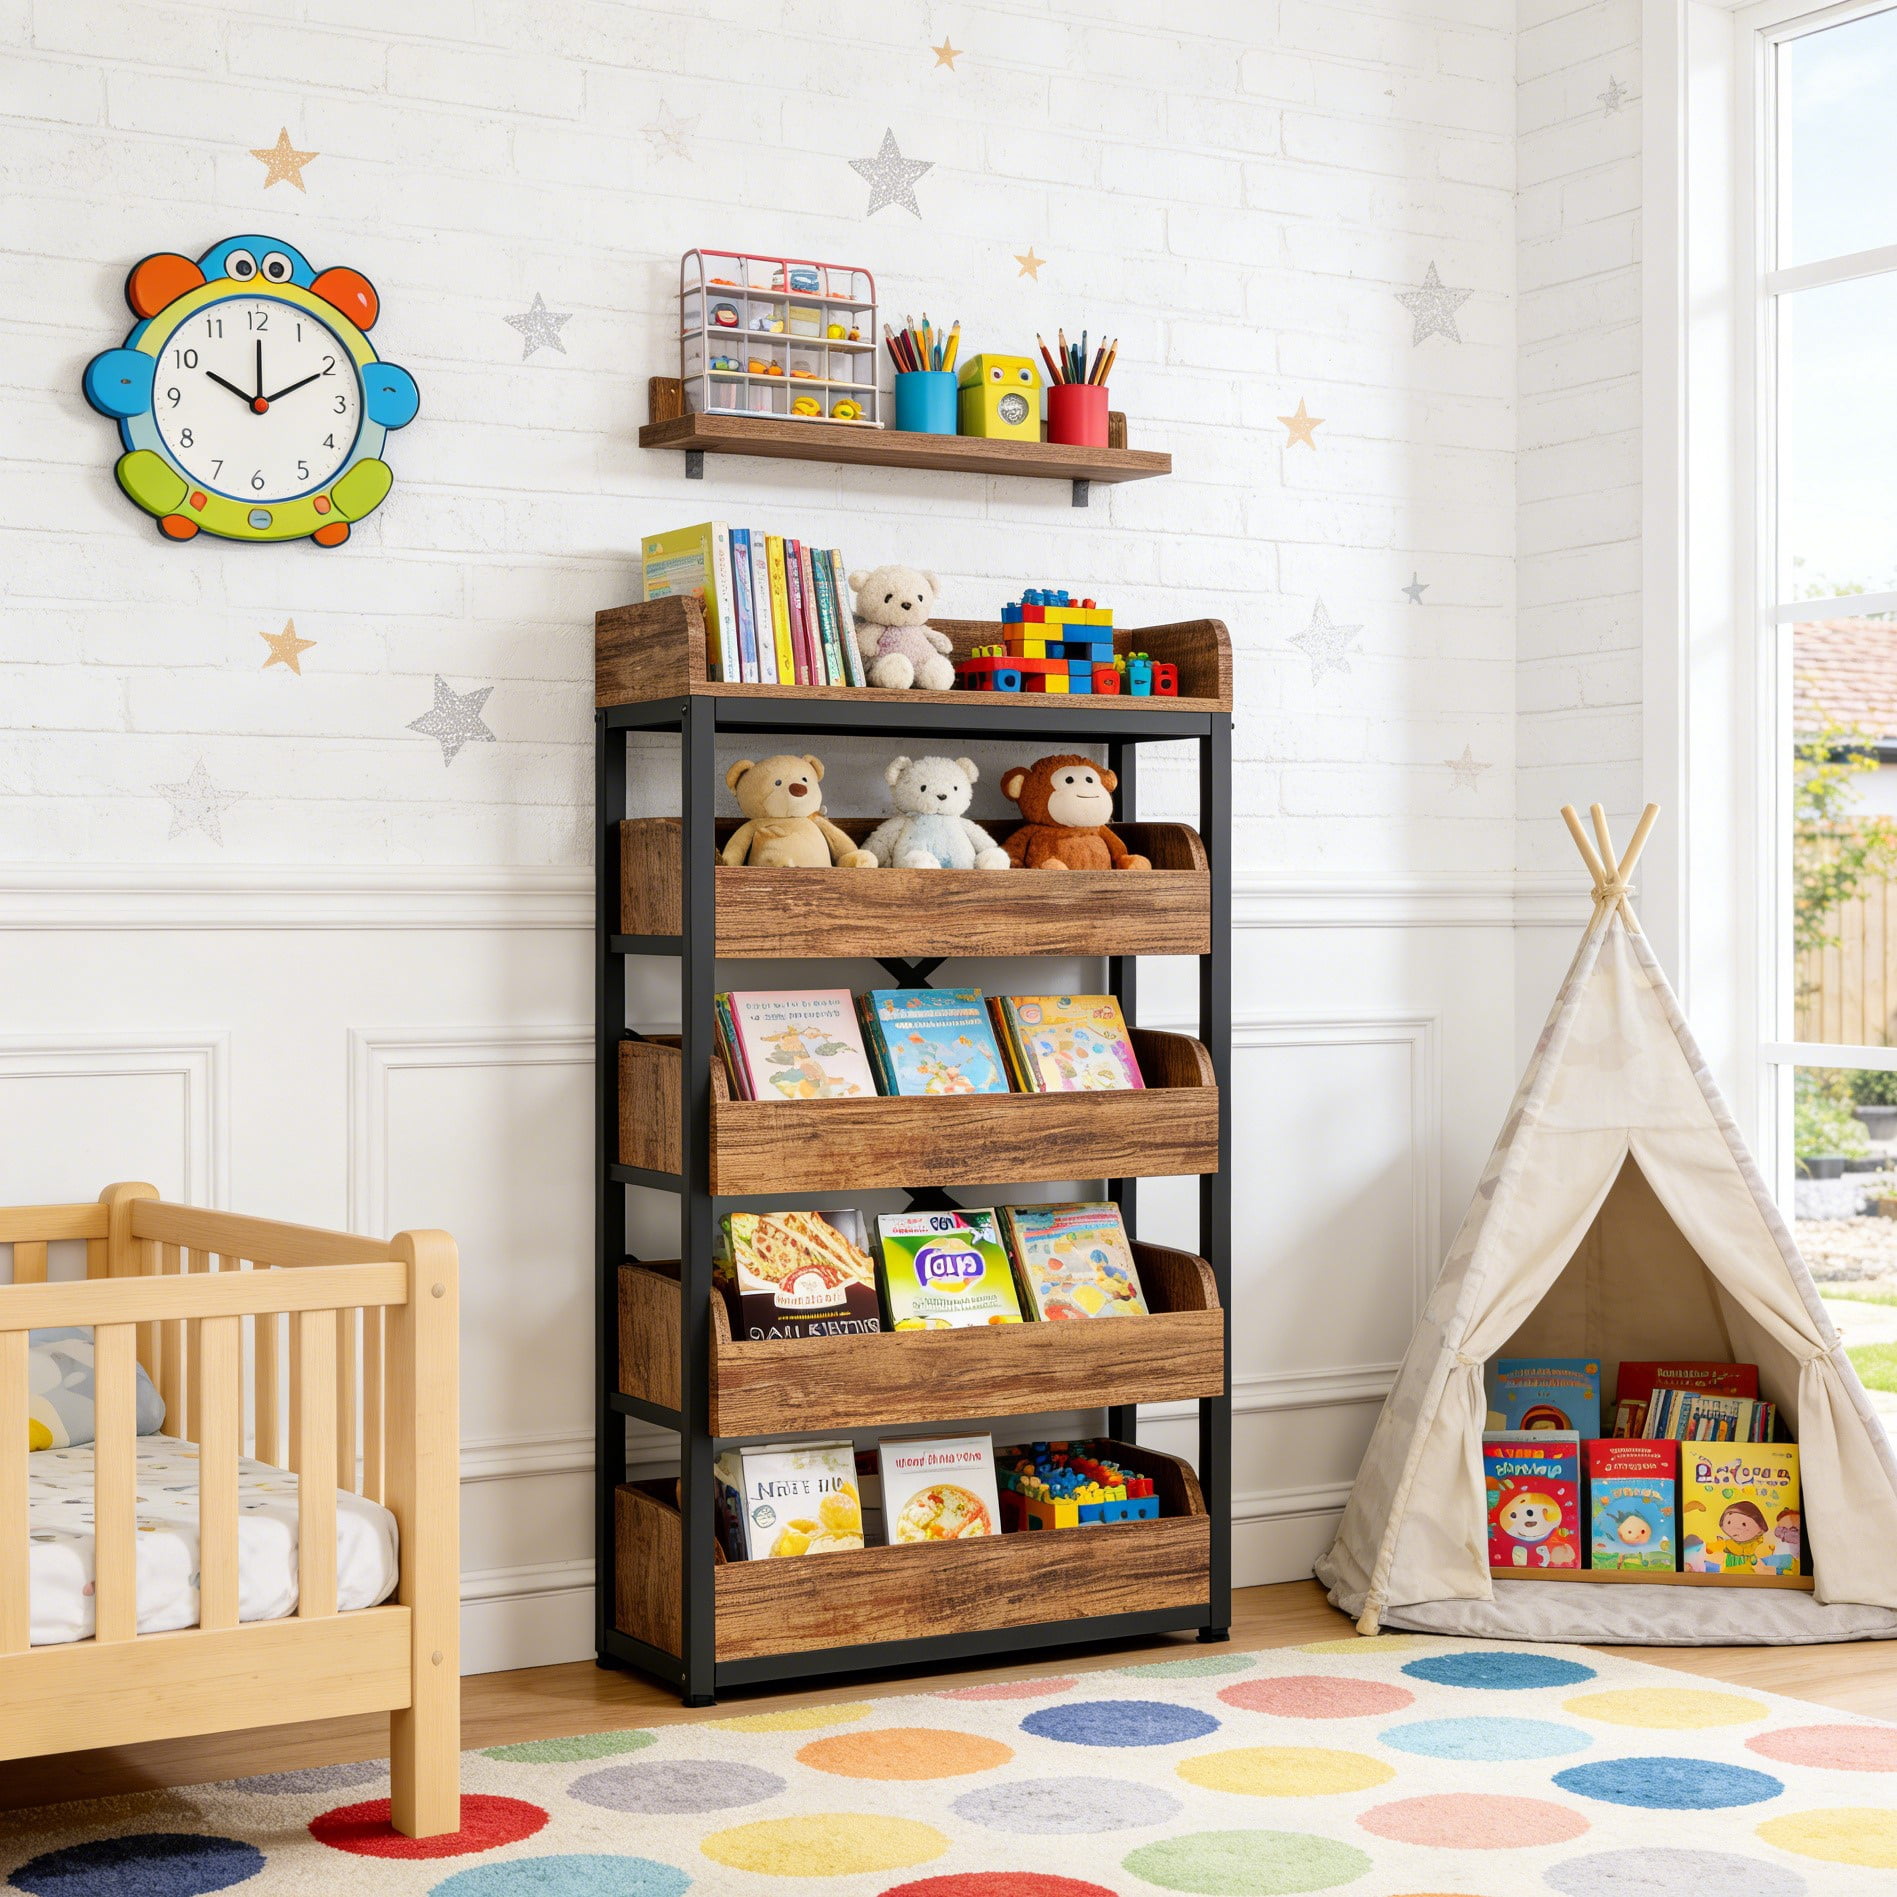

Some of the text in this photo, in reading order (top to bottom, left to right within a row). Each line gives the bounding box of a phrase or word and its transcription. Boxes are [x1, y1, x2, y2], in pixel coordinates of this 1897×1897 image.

[206, 318, 223, 338] 11
[247, 311, 269, 332] 12
[174, 348, 199, 369] 10
[322, 355, 337, 377] 2
[167, 387, 181, 408] 9
[333, 395, 347, 414] 3
[180, 428, 194, 449] 8
[322, 433, 335, 449] 4
[211, 460, 224, 480] 7
[251, 469, 265, 490] 6
[297, 460, 310, 481] 5
